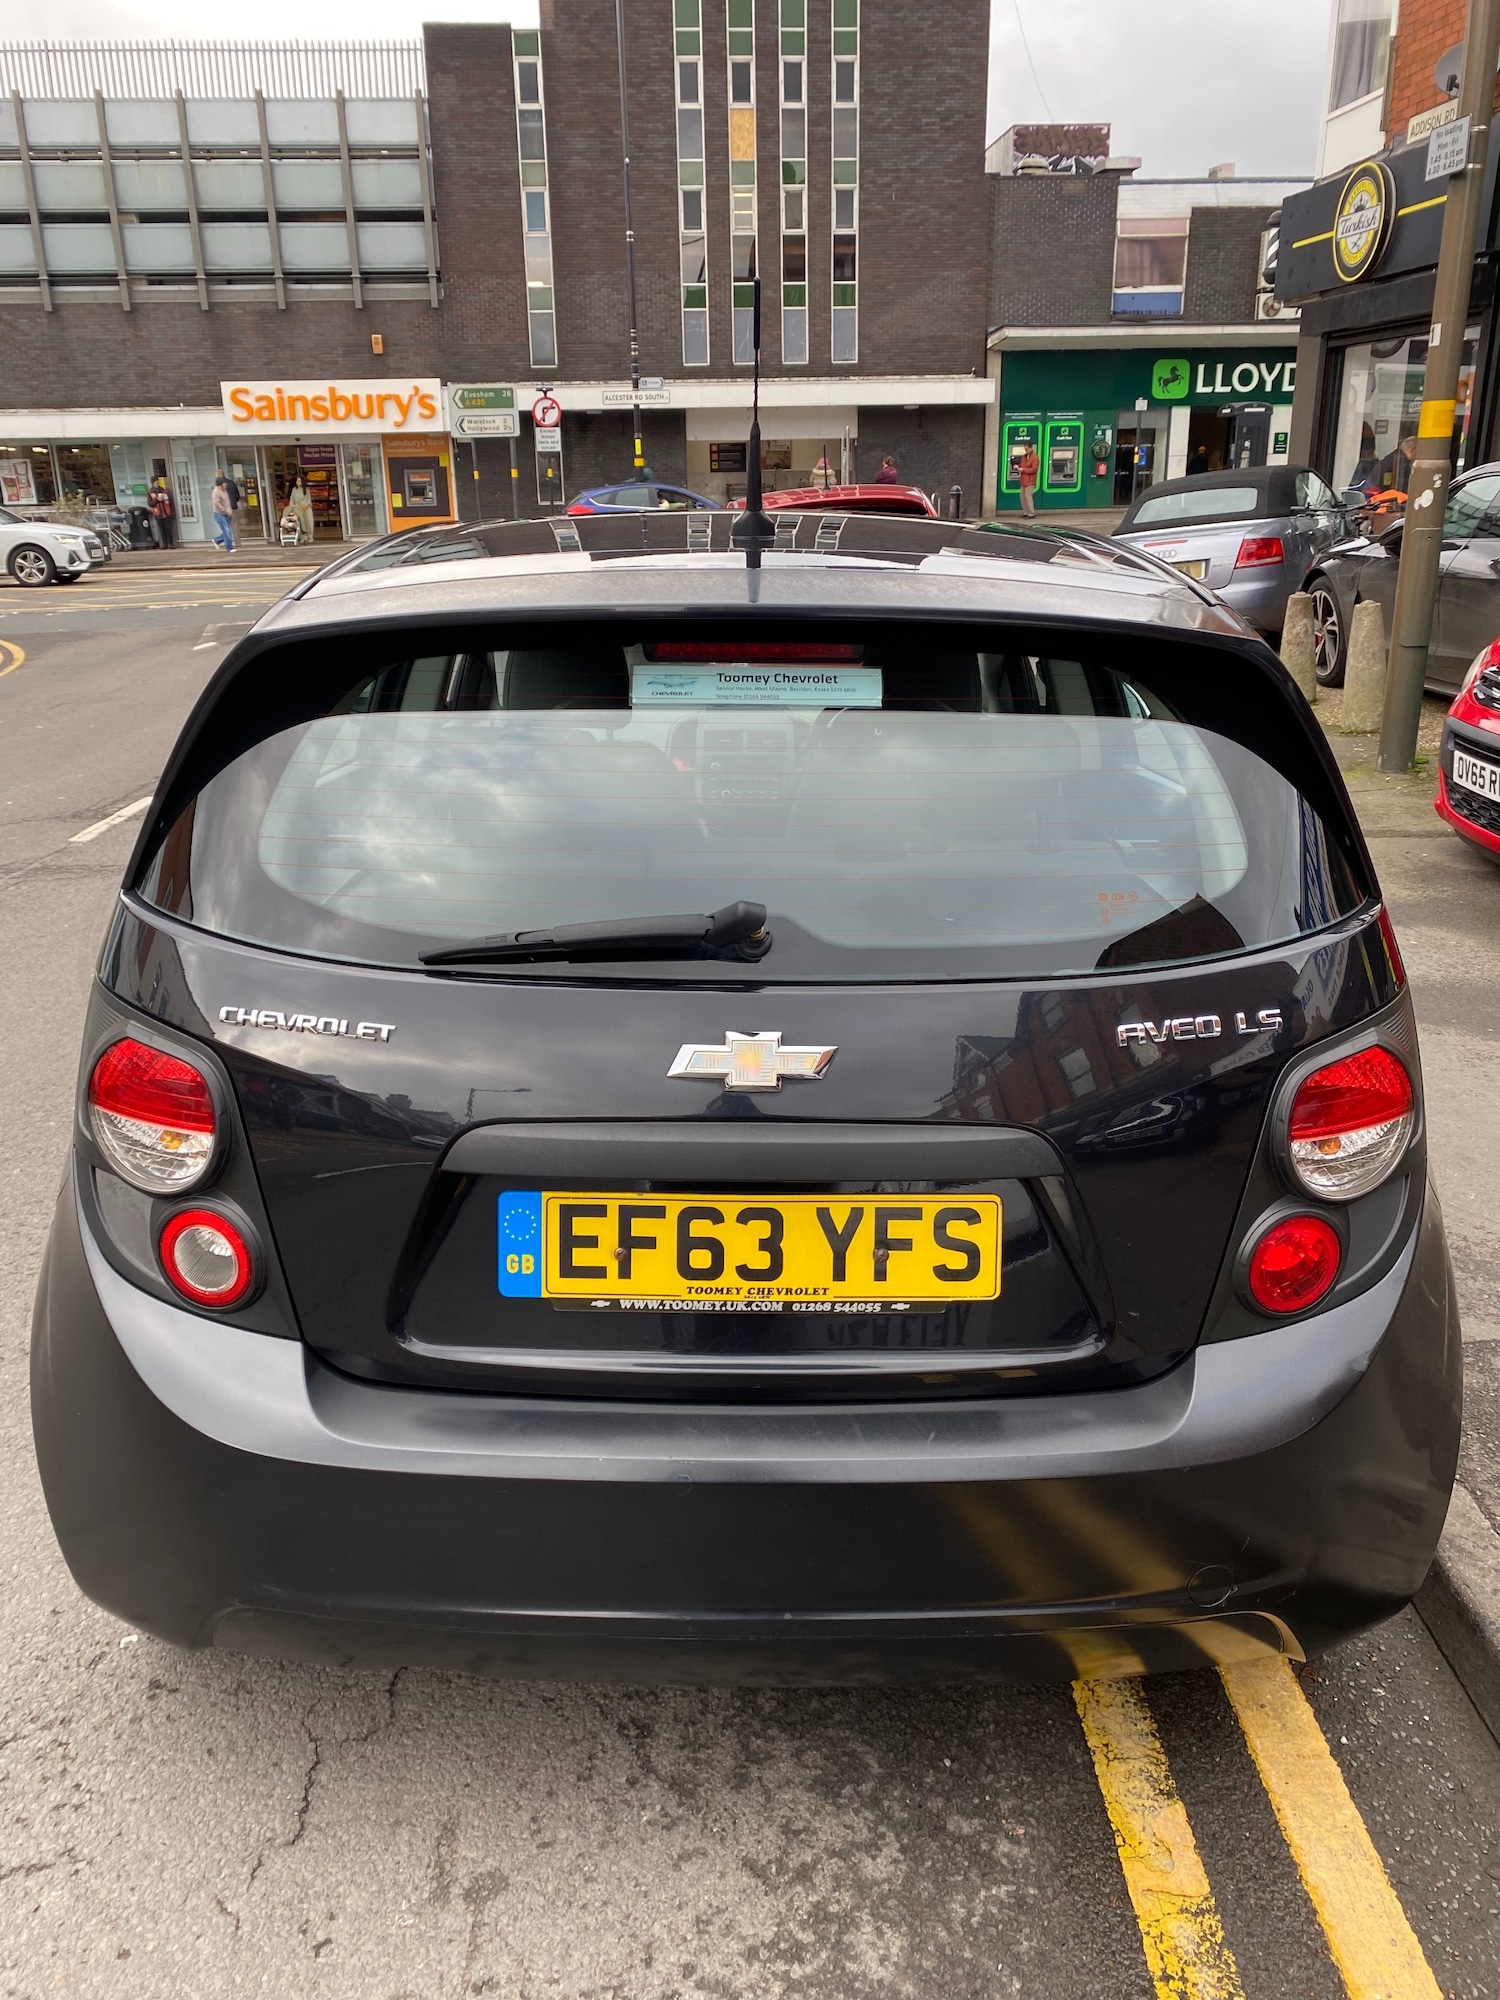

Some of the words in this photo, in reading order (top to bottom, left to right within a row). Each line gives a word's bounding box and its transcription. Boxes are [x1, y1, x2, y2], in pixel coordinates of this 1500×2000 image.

[1410, 113, 1442, 138] ADDISON
[1444, 108, 1455, 123] RD
[1340, 208, 1377, 235] Turkish
[229, 386, 436, 427] Sainsbury's
[605, 394, 633, 402] ALCESTER
[385, 439, 425, 448] Sainsbury's
[717, 673, 770, 685] Toomey
[774, 673, 838, 684] Chevrolet
[1458, 756, 1486, 789] OV65
[1489, 769, 1500, 796] R
[219, 1006, 396, 1042] CHEVROLET
[1116, 1014, 1222, 1047] AVEO
[1234, 1008, 1283, 1035] LS
[559, 1204, 784, 1281] EF63
[816, 1206, 982, 1282] YFS
[506, 1253, 534, 1274] GB
[686, 1286, 743, 1294] TOOMEY
[747, 1287, 830, 1296] CHEVROLET
[620, 1300, 783, 1312] WWW.TOOMEY.UK.COM
[792, 1303, 831, 1312] 01268
[833, 1303, 882, 1312] 544055
